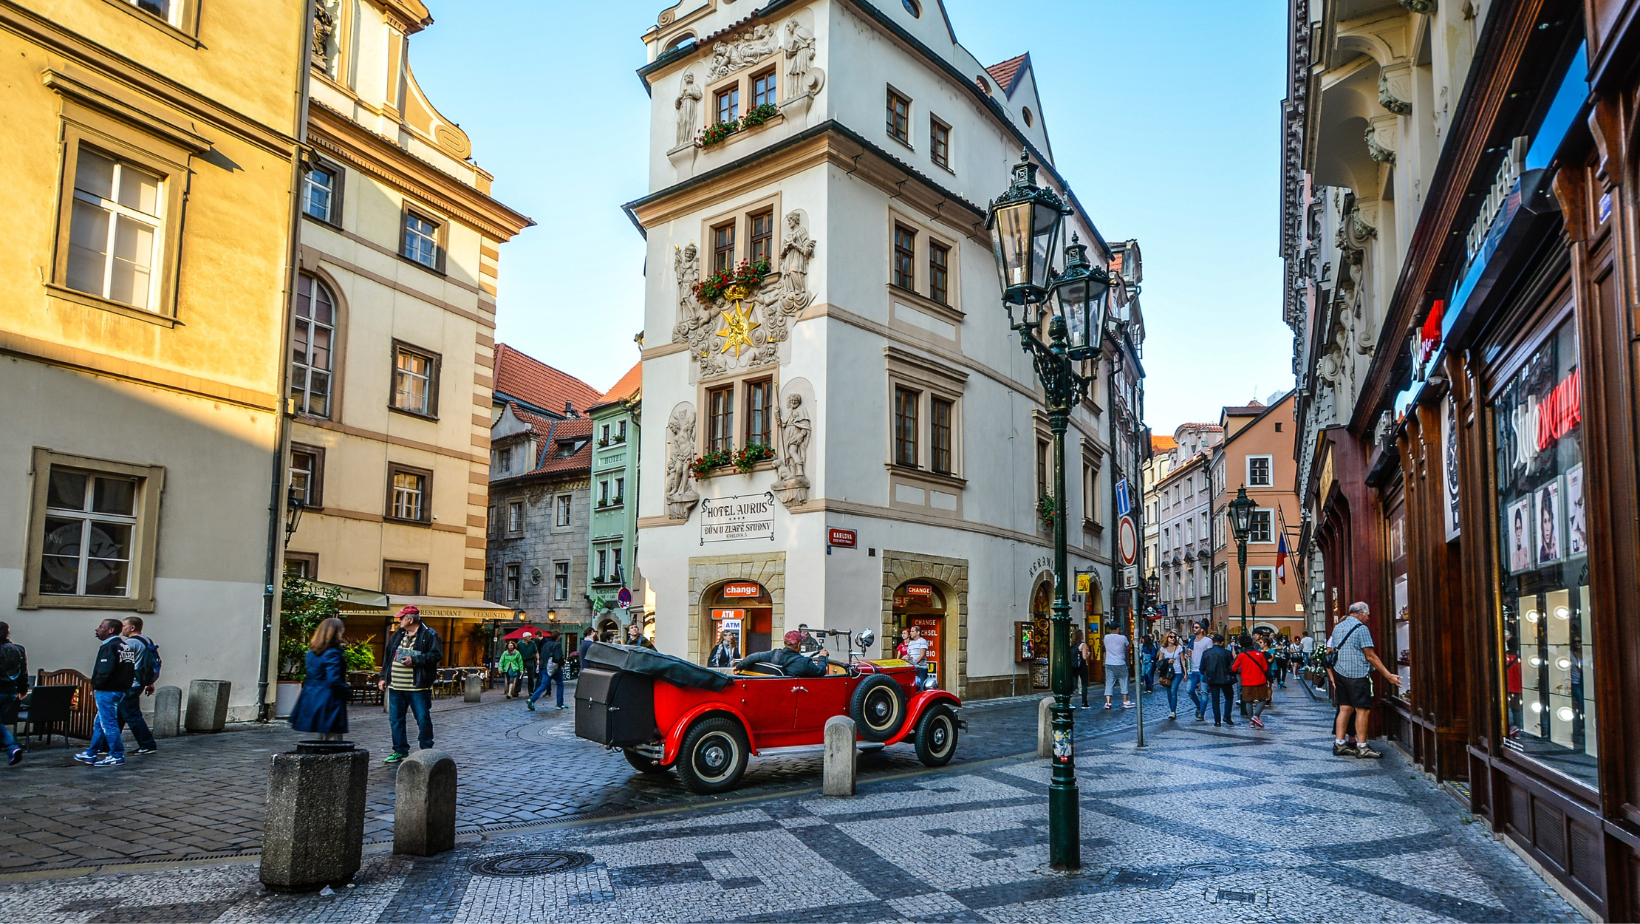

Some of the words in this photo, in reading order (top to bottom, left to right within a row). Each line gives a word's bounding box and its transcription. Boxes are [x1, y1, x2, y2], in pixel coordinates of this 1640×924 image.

[1467, 135, 1528, 268] JEWELLERY
[604, 454, 622, 464] HOTEL
[707, 505, 735, 518] HOTEL
[737, 502, 768, 515] AURUS
[720, 526, 724, 534] U
[725, 523, 745, 533] ZLATÉ
[746, 522, 771, 532] STUDNY
[833, 532, 853, 540] KARLOVA
[726, 586, 756, 595] change
[473, 611, 508, 619] CLEMENTIN
